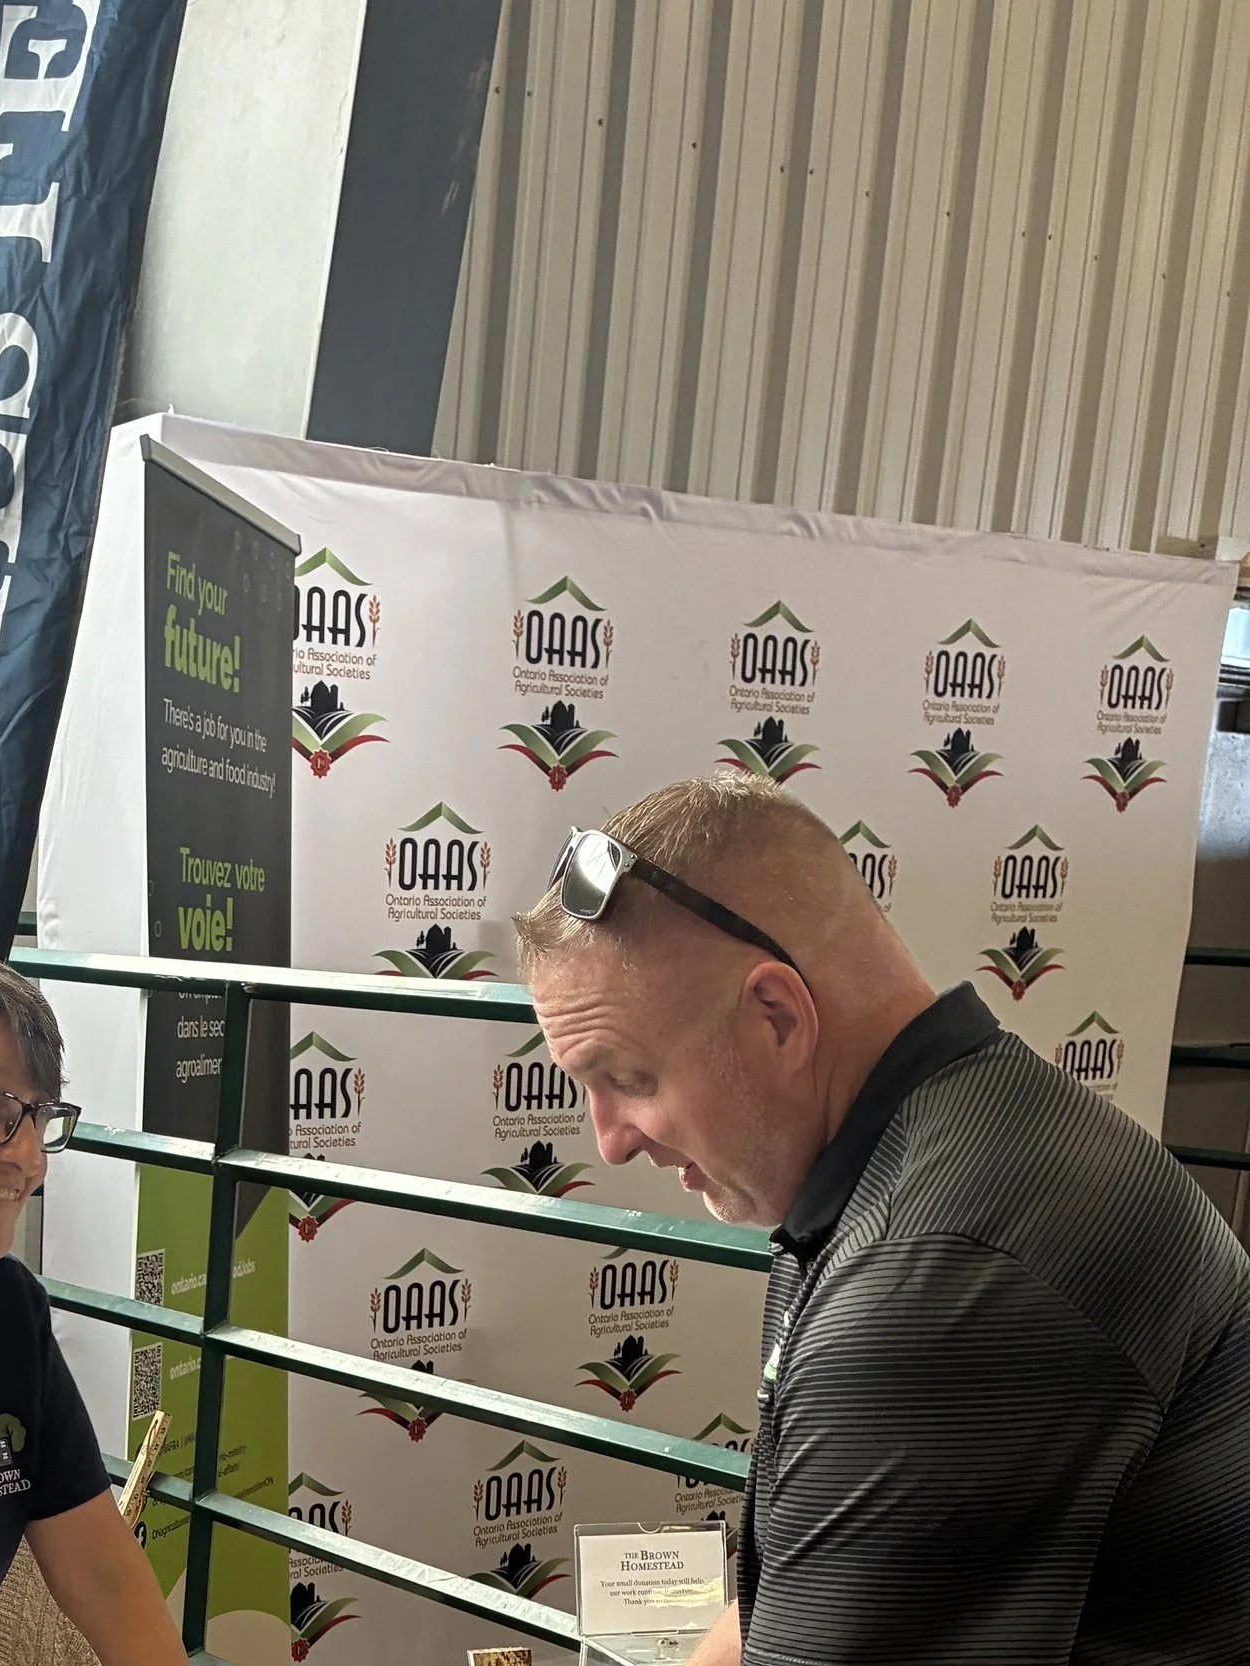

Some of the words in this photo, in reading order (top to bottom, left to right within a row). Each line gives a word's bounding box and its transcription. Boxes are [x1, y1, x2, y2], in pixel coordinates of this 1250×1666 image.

[166, 551, 195, 602] Find
[198, 576, 228, 616] your
[164, 604, 241, 693] future!
[308, 648, 363, 664] Association
[366, 653, 377, 666] of
[526, 610, 603, 669] OAAS
[741, 633, 811, 687] OAAS
[326, 664, 371, 679] Societies
[513, 666, 546, 680] Ontario
[549, 670, 598, 685] Association
[599, 675, 609, 686] of
[515, 680, 562, 696] Agricultural
[565, 684, 603, 699] Societies
[934, 650, 997, 699] OAAS
[1107, 664, 1166, 710] OAAS
[164, 698, 195, 731] There's
[196, 715, 201, 733] a
[202, 711, 216, 740] job
[217, 715, 228, 742] for
[230, 724, 246, 749] you
[247, 725, 254, 746] in
[255, 727, 267, 753] the
[161, 744, 208, 775] agriculture
[209, 757, 224, 780] and
[226, 759, 246, 785] food
[247, 764, 276, 799] industry!
[180, 847, 231, 888] Trouvez
[235, 859, 265, 893] votre
[399, 837, 480, 891] OAAS
[1001, 854, 1061, 899] OAAS
[178, 894, 233, 952] voie!
[386, 894, 421, 906] Ontario
[424, 895, 475, 907] Association
[477, 896, 487, 907] of
[388, 907, 438, 922] Agricultural
[440, 908, 481, 920] Societies
[178, 1016, 199, 1039] dans
[200, 1016, 208, 1037] le
[493, 1115, 525, 1126] Ontario
[528, 1114, 575, 1125] Association
[577, 1112, 585, 1123] of
[495, 1126, 541, 1141] Agricultural
[543, 1126, 580, 1136] Societies
[383, 1279, 461, 1334] OAAS
[600, 1260, 670, 1310] OAAS
[371, 1337, 404, 1349] Ontario
[407, 1331, 456, 1345] Association
[458, 1328, 467, 1340] of
[423, 1343, 462, 1355] Societies
[485, 1467, 557, 1521] OAAS
[620, 1561, 684, 1571] HOMESTEAD
[641, 1550, 680, 1560] BROWN
